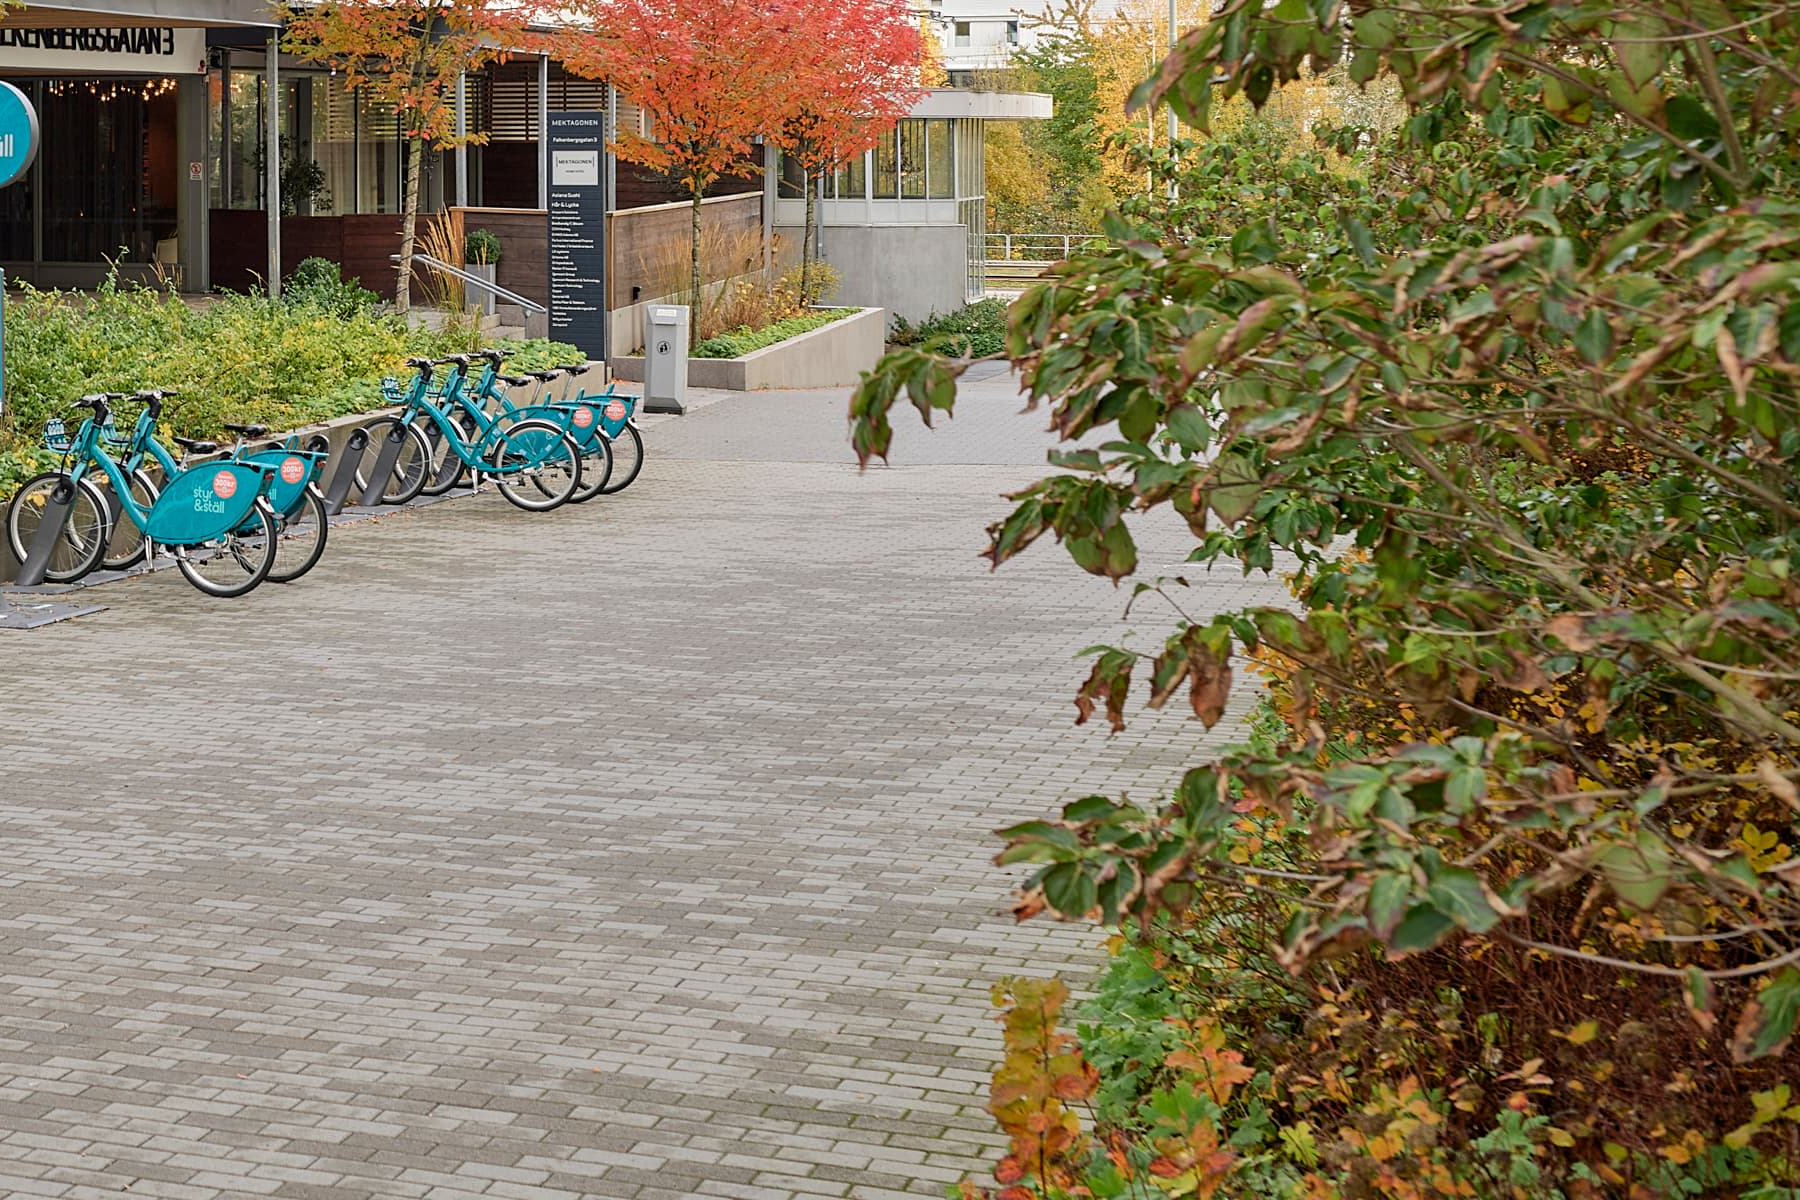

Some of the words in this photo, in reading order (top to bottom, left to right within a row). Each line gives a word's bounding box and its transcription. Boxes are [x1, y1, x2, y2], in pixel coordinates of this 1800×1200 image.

[162, 27, 175, 55] 3
[193, 485, 214, 502] styr
[194, 498, 225, 513] &ställ
